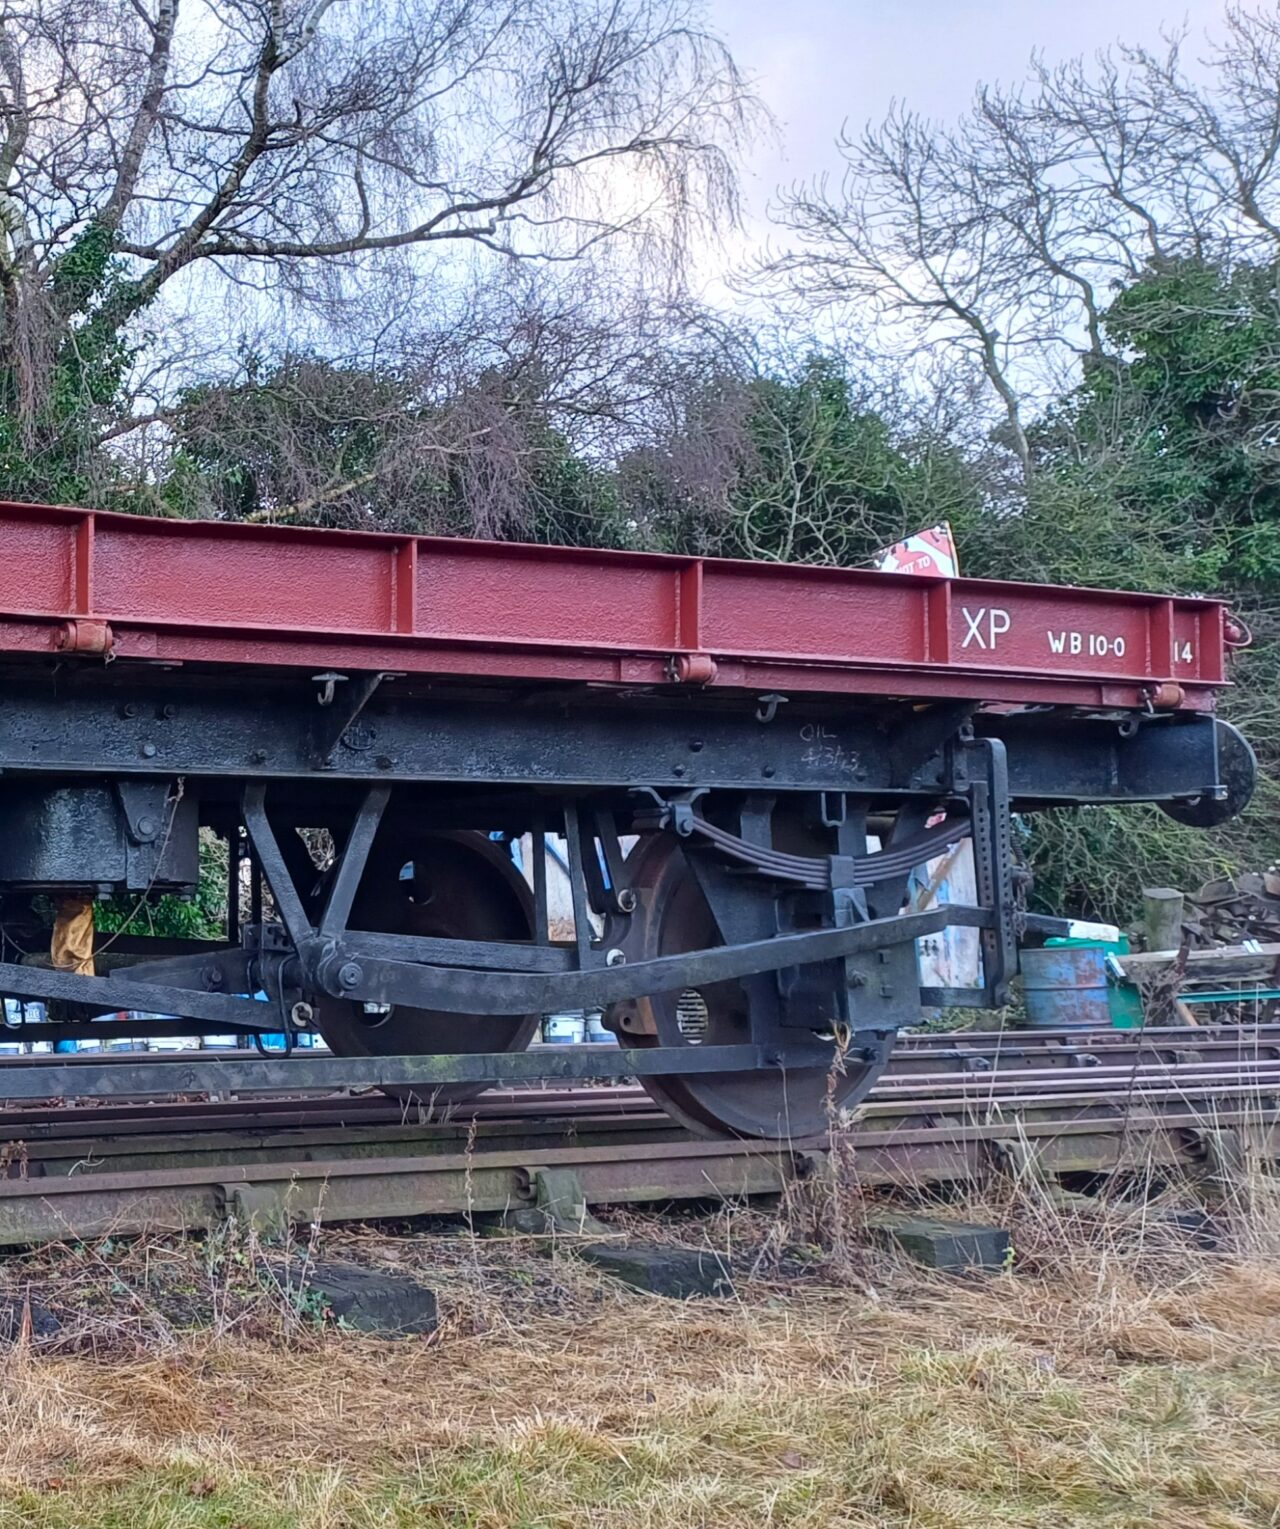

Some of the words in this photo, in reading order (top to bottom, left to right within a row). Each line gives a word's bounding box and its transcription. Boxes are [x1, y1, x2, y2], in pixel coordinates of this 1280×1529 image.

[961, 607, 1012, 650] XP
[1047, 631, 1082, 655] WB
[1173, 641, 1193, 664] 14
